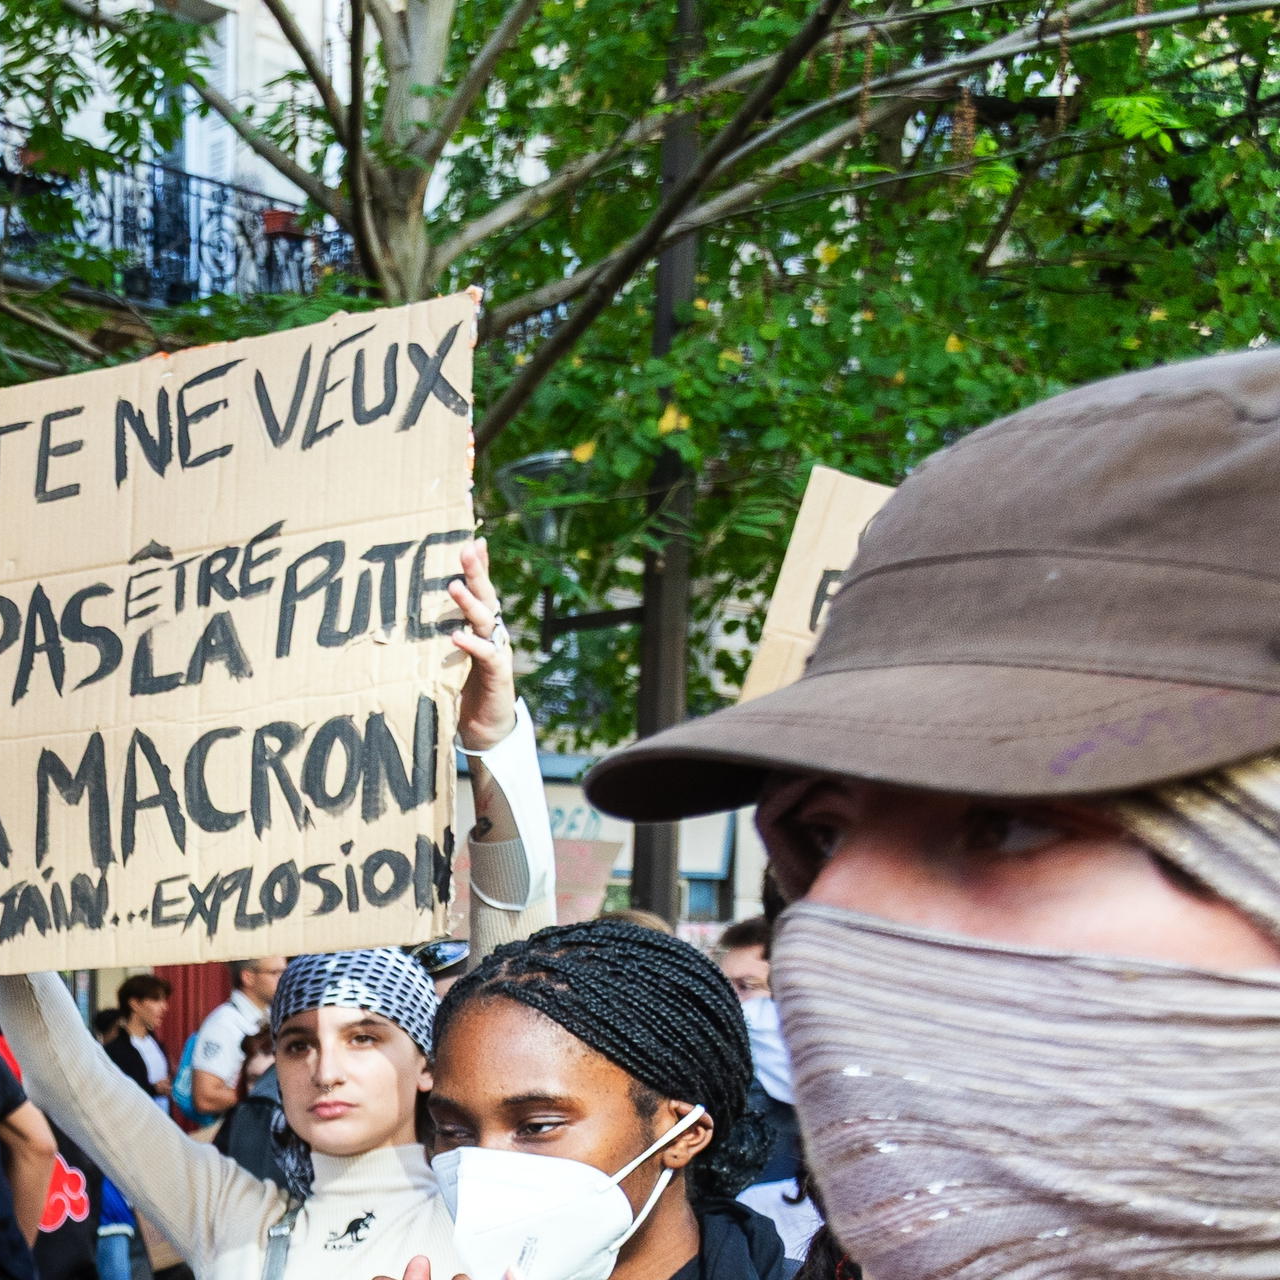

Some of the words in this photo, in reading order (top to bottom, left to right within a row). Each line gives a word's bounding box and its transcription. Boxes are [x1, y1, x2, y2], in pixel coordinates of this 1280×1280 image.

[113, 356, 250, 490] NE
[253, 320, 472, 453] VEUX
[128, 609, 255, 698] LA
[275, 528, 470, 660] PUTE
[35, 691, 440, 870] MACRON
